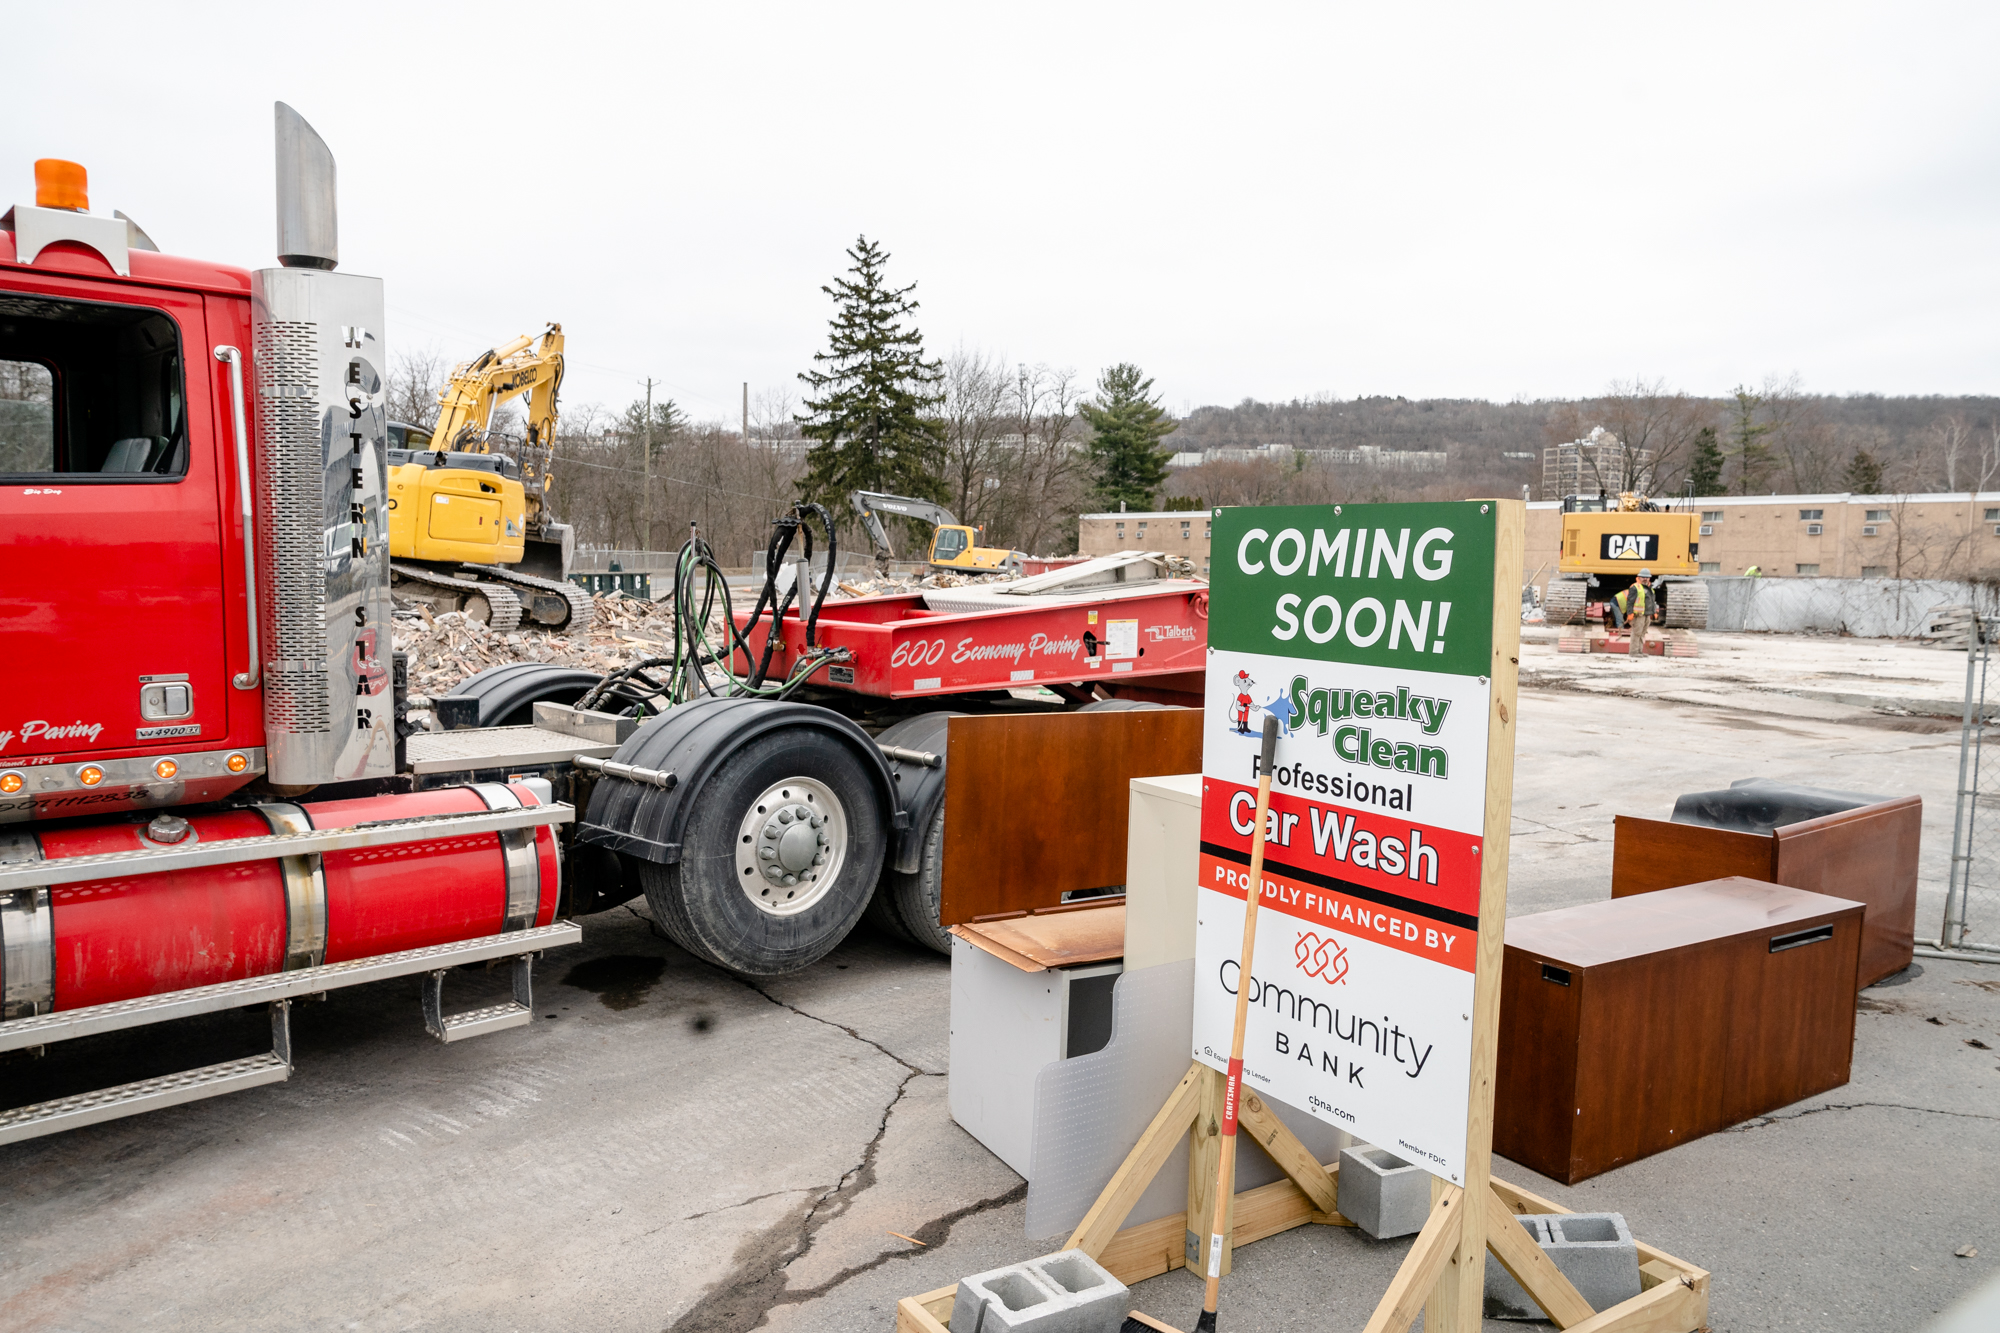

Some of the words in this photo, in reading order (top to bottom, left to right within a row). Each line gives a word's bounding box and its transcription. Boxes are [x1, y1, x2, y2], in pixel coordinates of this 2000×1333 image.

[341, 325, 367, 559] WESTERN
[882, 502, 908, 512] VOLVO
[1237, 527, 1455, 581] COMING
[1608, 534, 1650, 560] CAT
[1164, 625, 1194, 637] Talbert
[1271, 593, 1452, 654] SOON!
[354, 606, 373, 730] STAR
[891, 638, 945, 668] 600
[951, 637, 1025, 665] Economy
[1029, 633, 1081, 660] Paving
[1288, 674, 1452, 737] Squeaky
[20, 720, 104, 743] Paving
[155, 727, 185, 736] 4900
[1333, 724, 1449, 779] Clean
[1228, 790, 1300, 848] Car
[1308, 806, 1439, 886] Wash
[1305, 892, 1419, 942] FINANCED
[1425, 927, 1456, 953] BY
[1213, 1052, 1228, 1064] Equal
[1276, 1031, 1364, 1089] BANK
[1251, 1070, 1271, 1083] Lender
[1308, 1094, 1355, 1123] cbna.com
[1398, 1139, 1427, 1157] Member
[1428, 1152, 1446, 1166] FDIC
